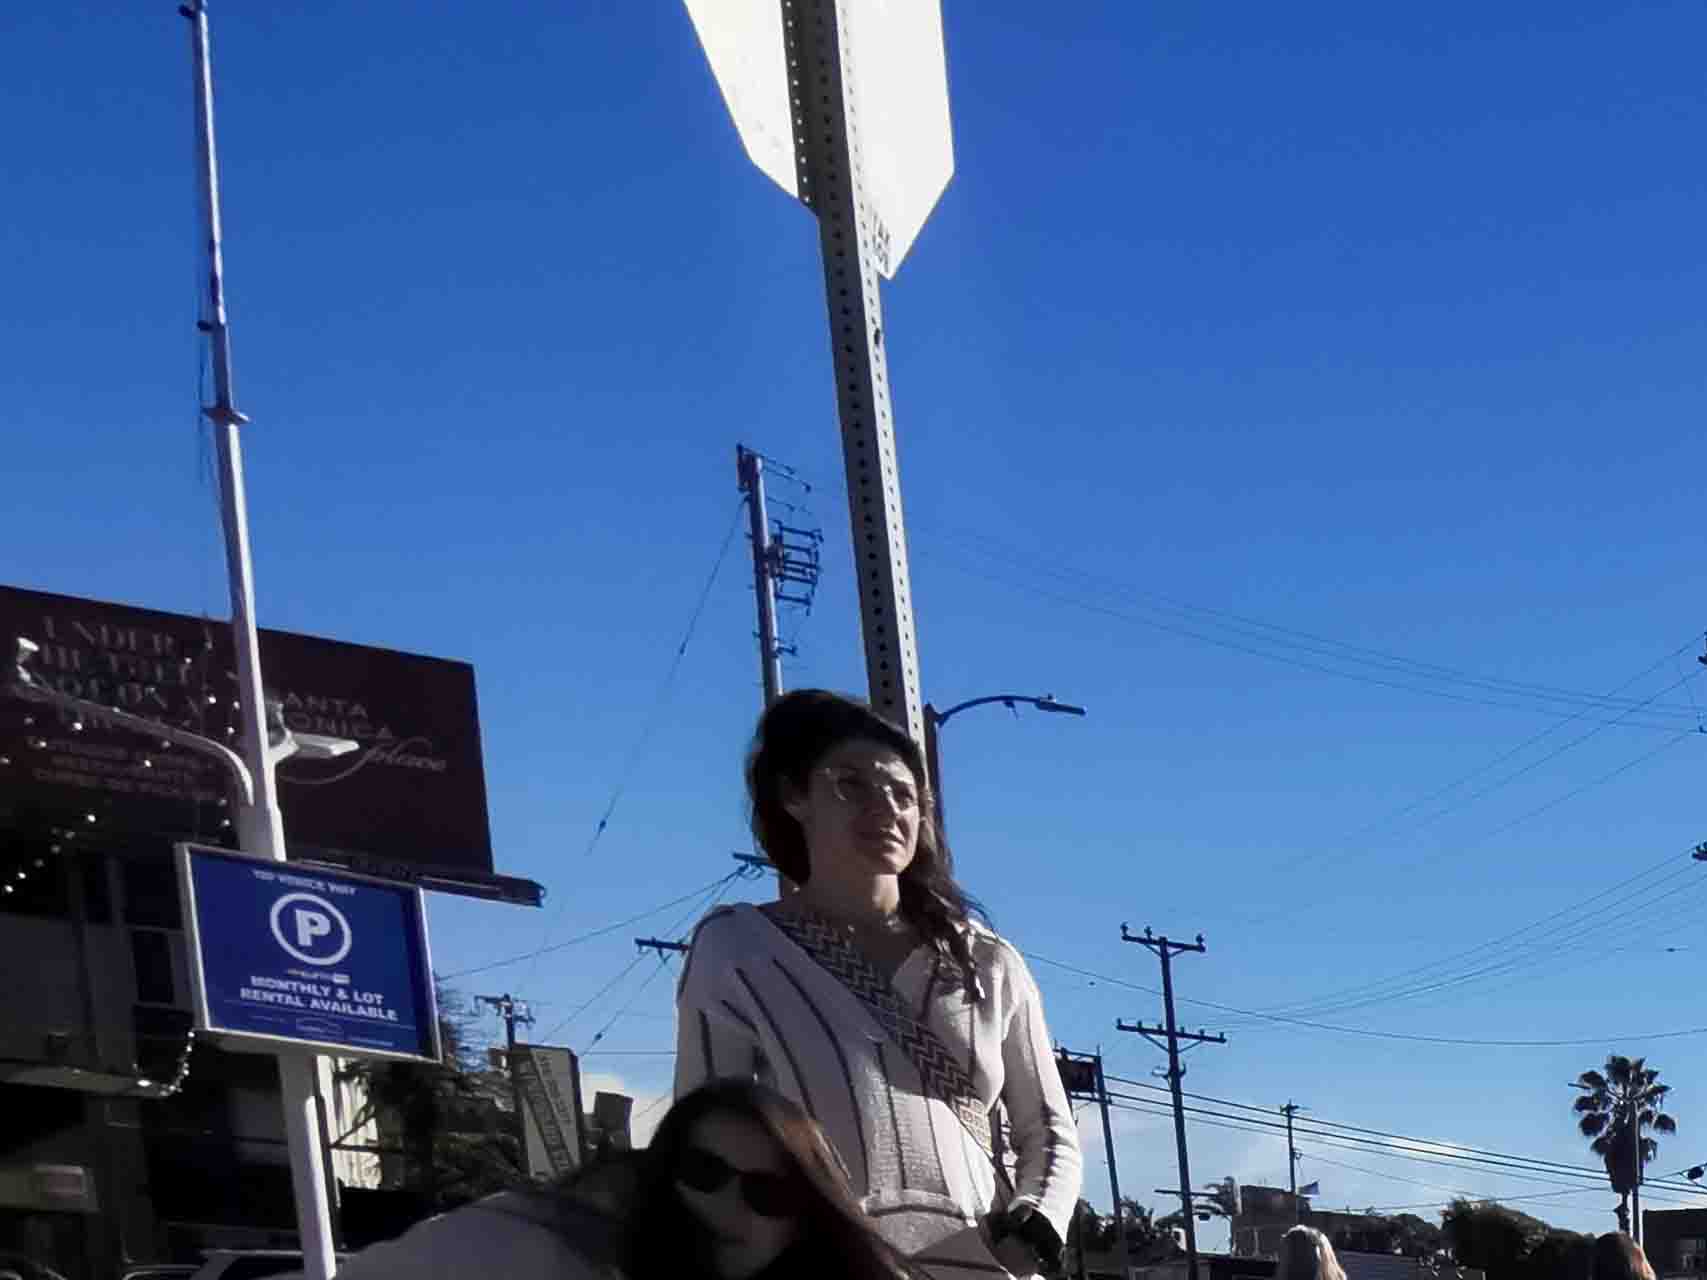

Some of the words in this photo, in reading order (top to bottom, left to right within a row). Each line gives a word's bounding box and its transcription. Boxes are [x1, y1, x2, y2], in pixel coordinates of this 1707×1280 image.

[285, 688, 369, 720] ANTA
[286, 711, 393, 742] ONICA
[294, 908, 332, 947] P
[239, 986, 306, 1007] RENTAL
[309, 997, 401, 1022] AVAILABLE
[250, 974, 332, 998] MONTHLY
[336, 988, 350, 1000] &
[353, 990, 385, 1006] LOT
